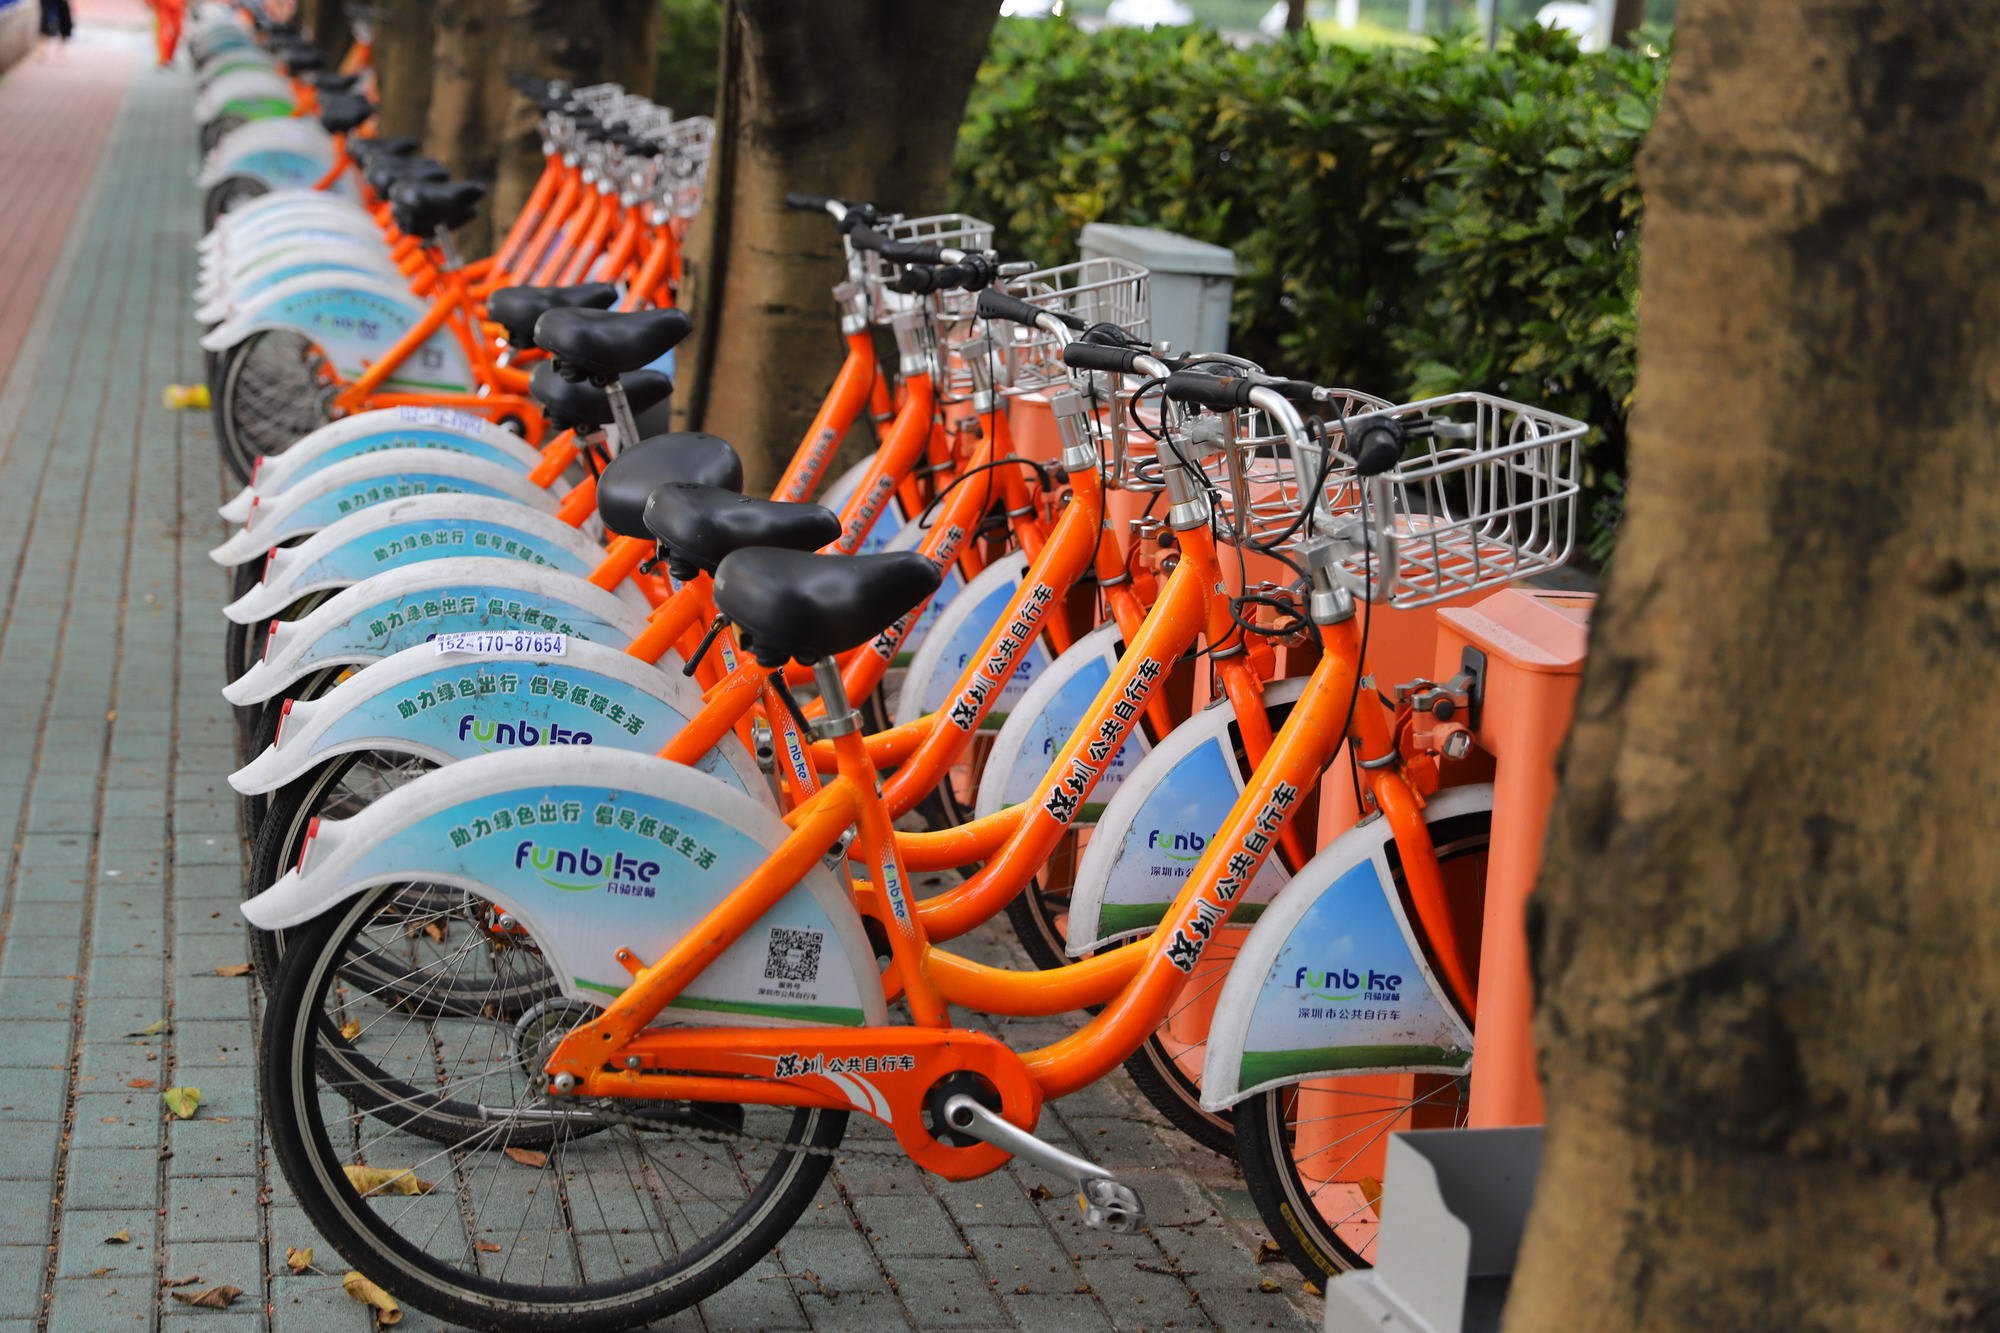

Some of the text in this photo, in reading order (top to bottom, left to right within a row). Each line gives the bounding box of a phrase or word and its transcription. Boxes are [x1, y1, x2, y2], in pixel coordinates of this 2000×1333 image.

[369, 597, 477, 638] 助力绿色出行
[987, 583, 1053, 675] 公共自行车
[438, 635, 562, 654] 152-170-87654
[397, 674, 645, 736] 助力绿色出行 倡导低碳生活
[1088, 657, 1161, 762] 公共自行车
[448, 802, 718, 871] 助力绿色出行 倡导低碳生活
[1216, 782, 1297, 900] 公共自行车
[515, 840, 661, 883] funbike
[1294, 966, 1403, 991] funbike
[1297, 1007, 1401, 1021] 深圳市公共自行车
[828, 1055, 914, 1073] 公共自行车
